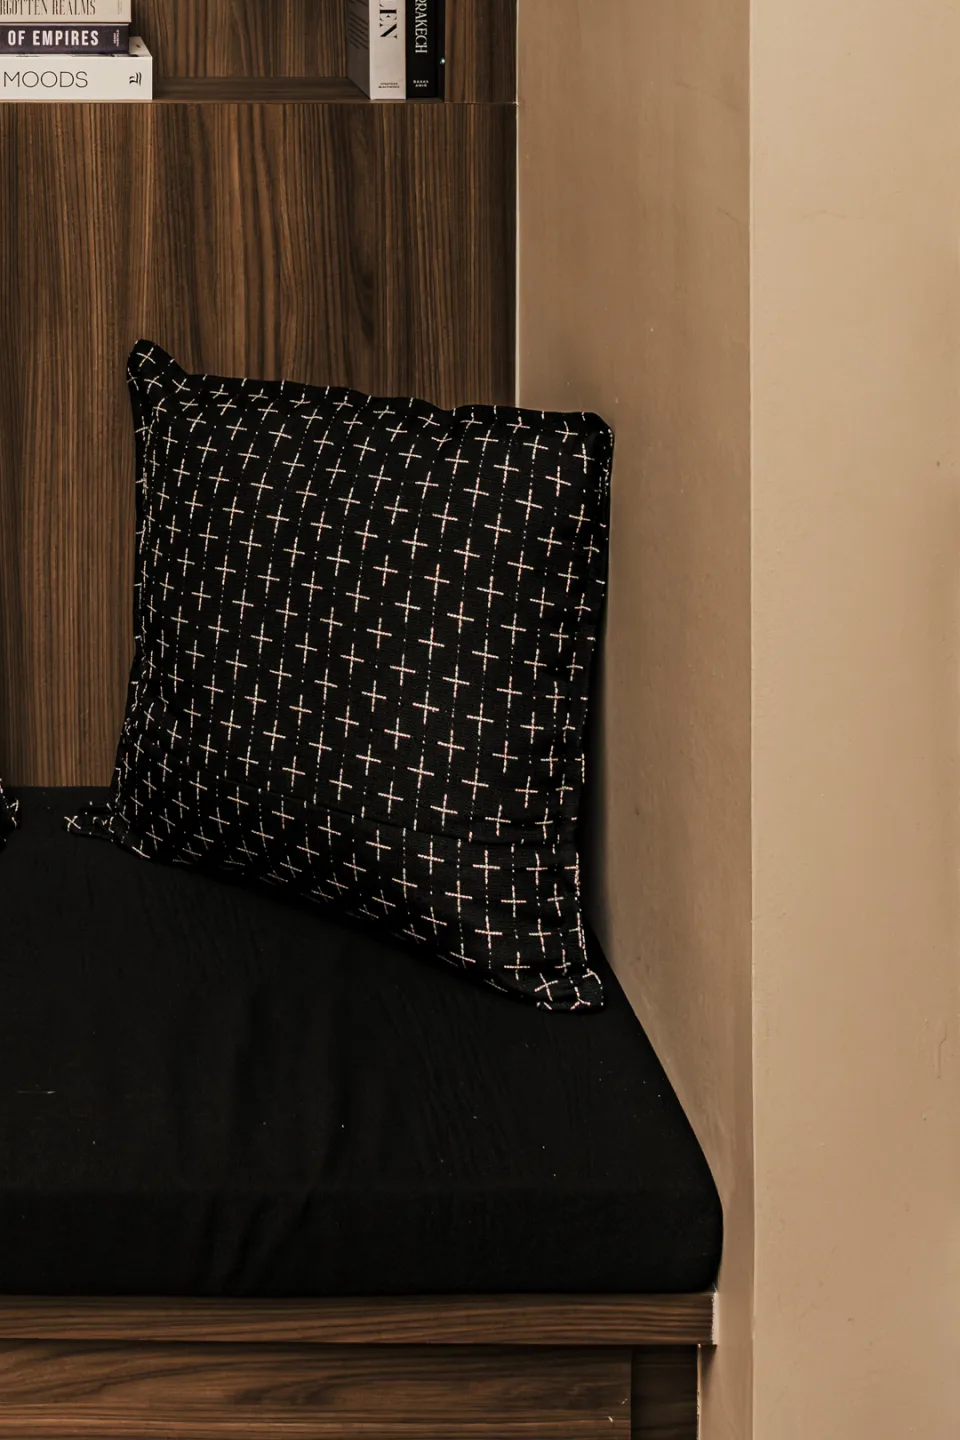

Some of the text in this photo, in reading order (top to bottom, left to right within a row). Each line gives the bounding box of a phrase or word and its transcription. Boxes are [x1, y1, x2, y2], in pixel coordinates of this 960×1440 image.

[52, 0, 96, 15] REALMS
[8, 30, 25, 45] OF
[33, 30, 99, 45] EMPIRES
[4, 71, 88, 88] MOODS
